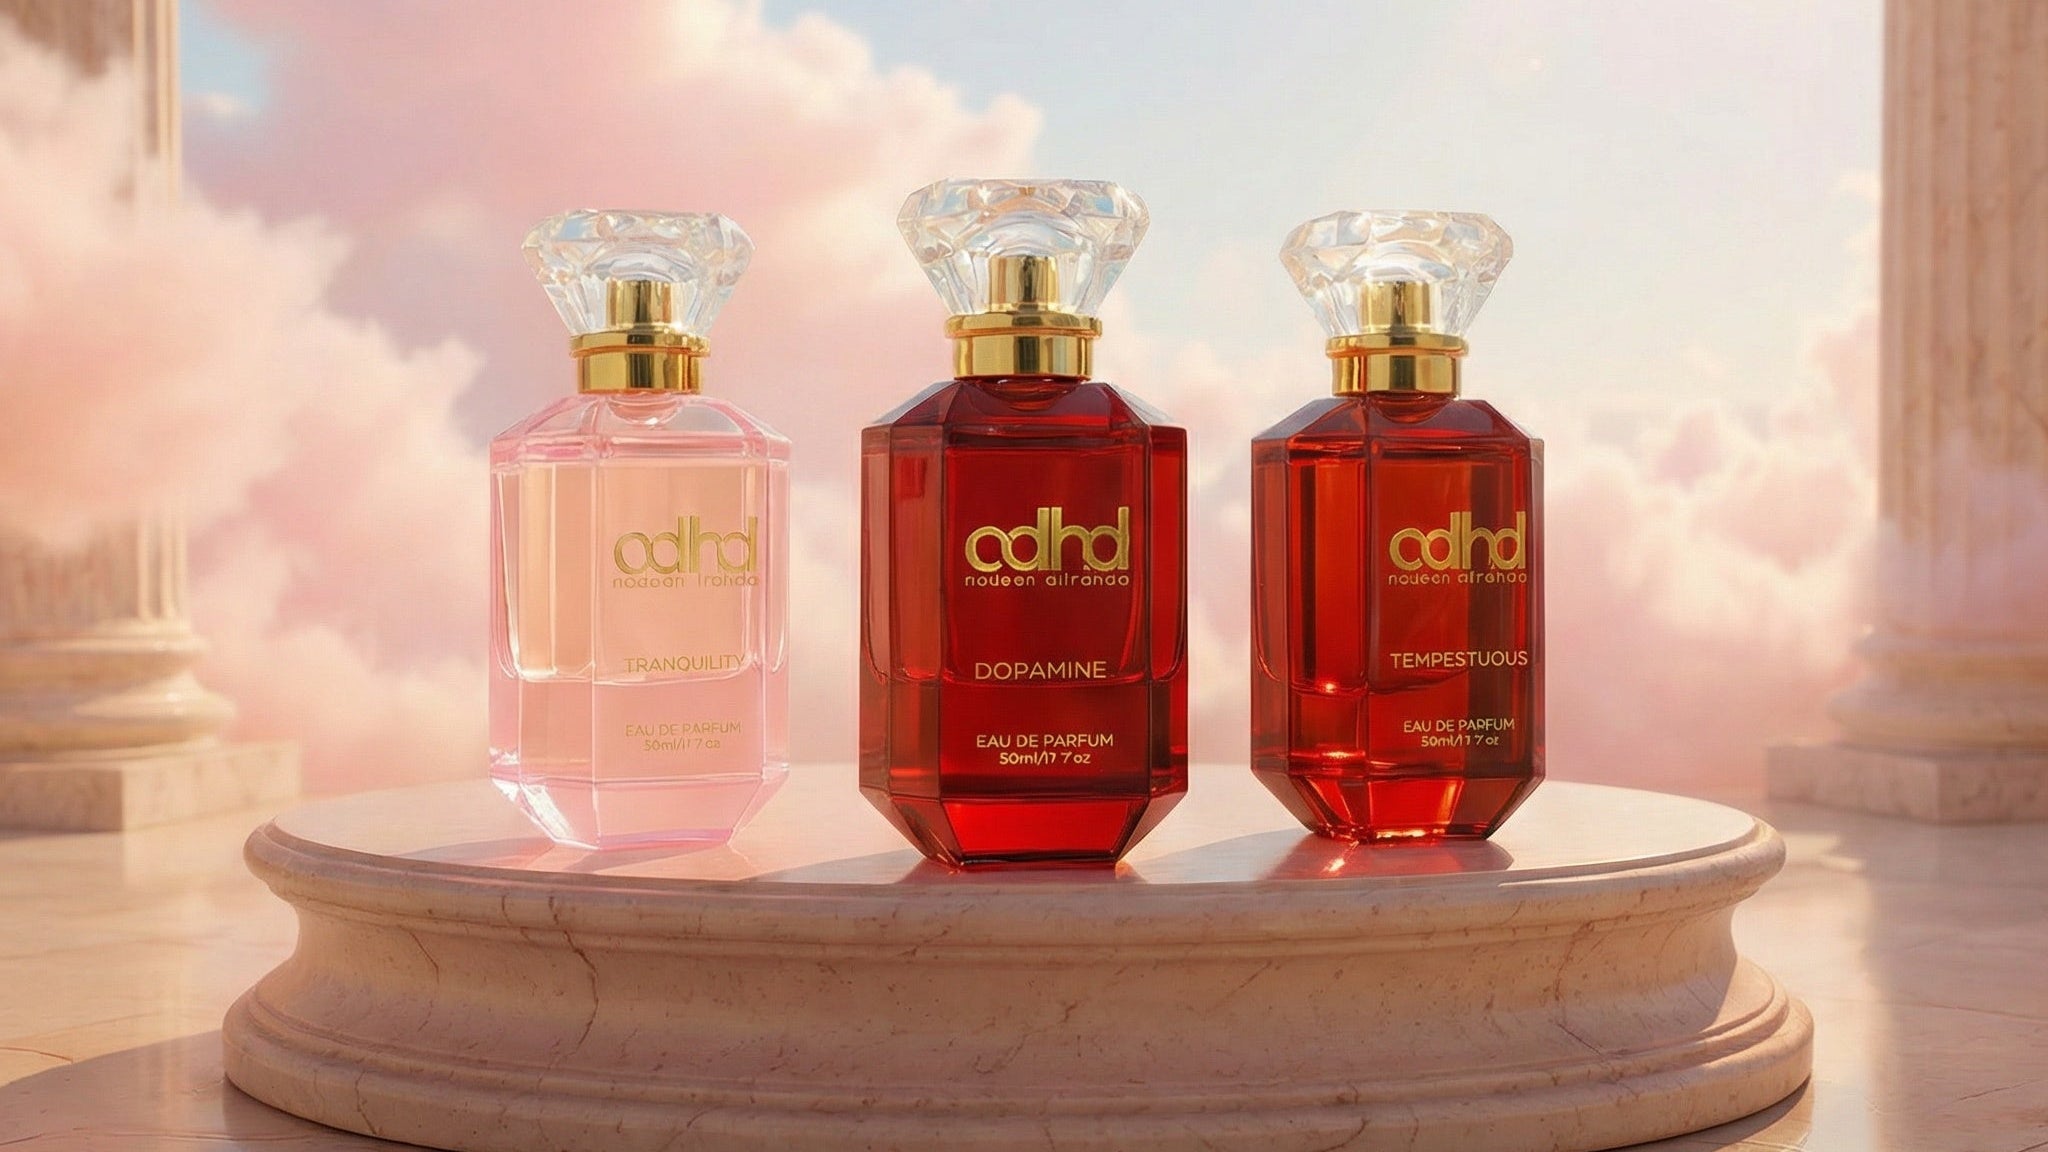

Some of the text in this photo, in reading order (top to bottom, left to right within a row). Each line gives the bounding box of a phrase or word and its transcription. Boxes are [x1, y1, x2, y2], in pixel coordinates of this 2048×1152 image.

[624, 655, 746, 673] TRANQUILITY
[1390, 650, 1529, 669] TEMPESTUOUS
[975, 661, 1107, 680] DOPAMINE
[625, 721, 742, 737] EAU DE PARFUM
[1403, 718, 1516, 733] EAU DE PARFUM
[976, 733, 1114, 748] EAU DE PARFUM
